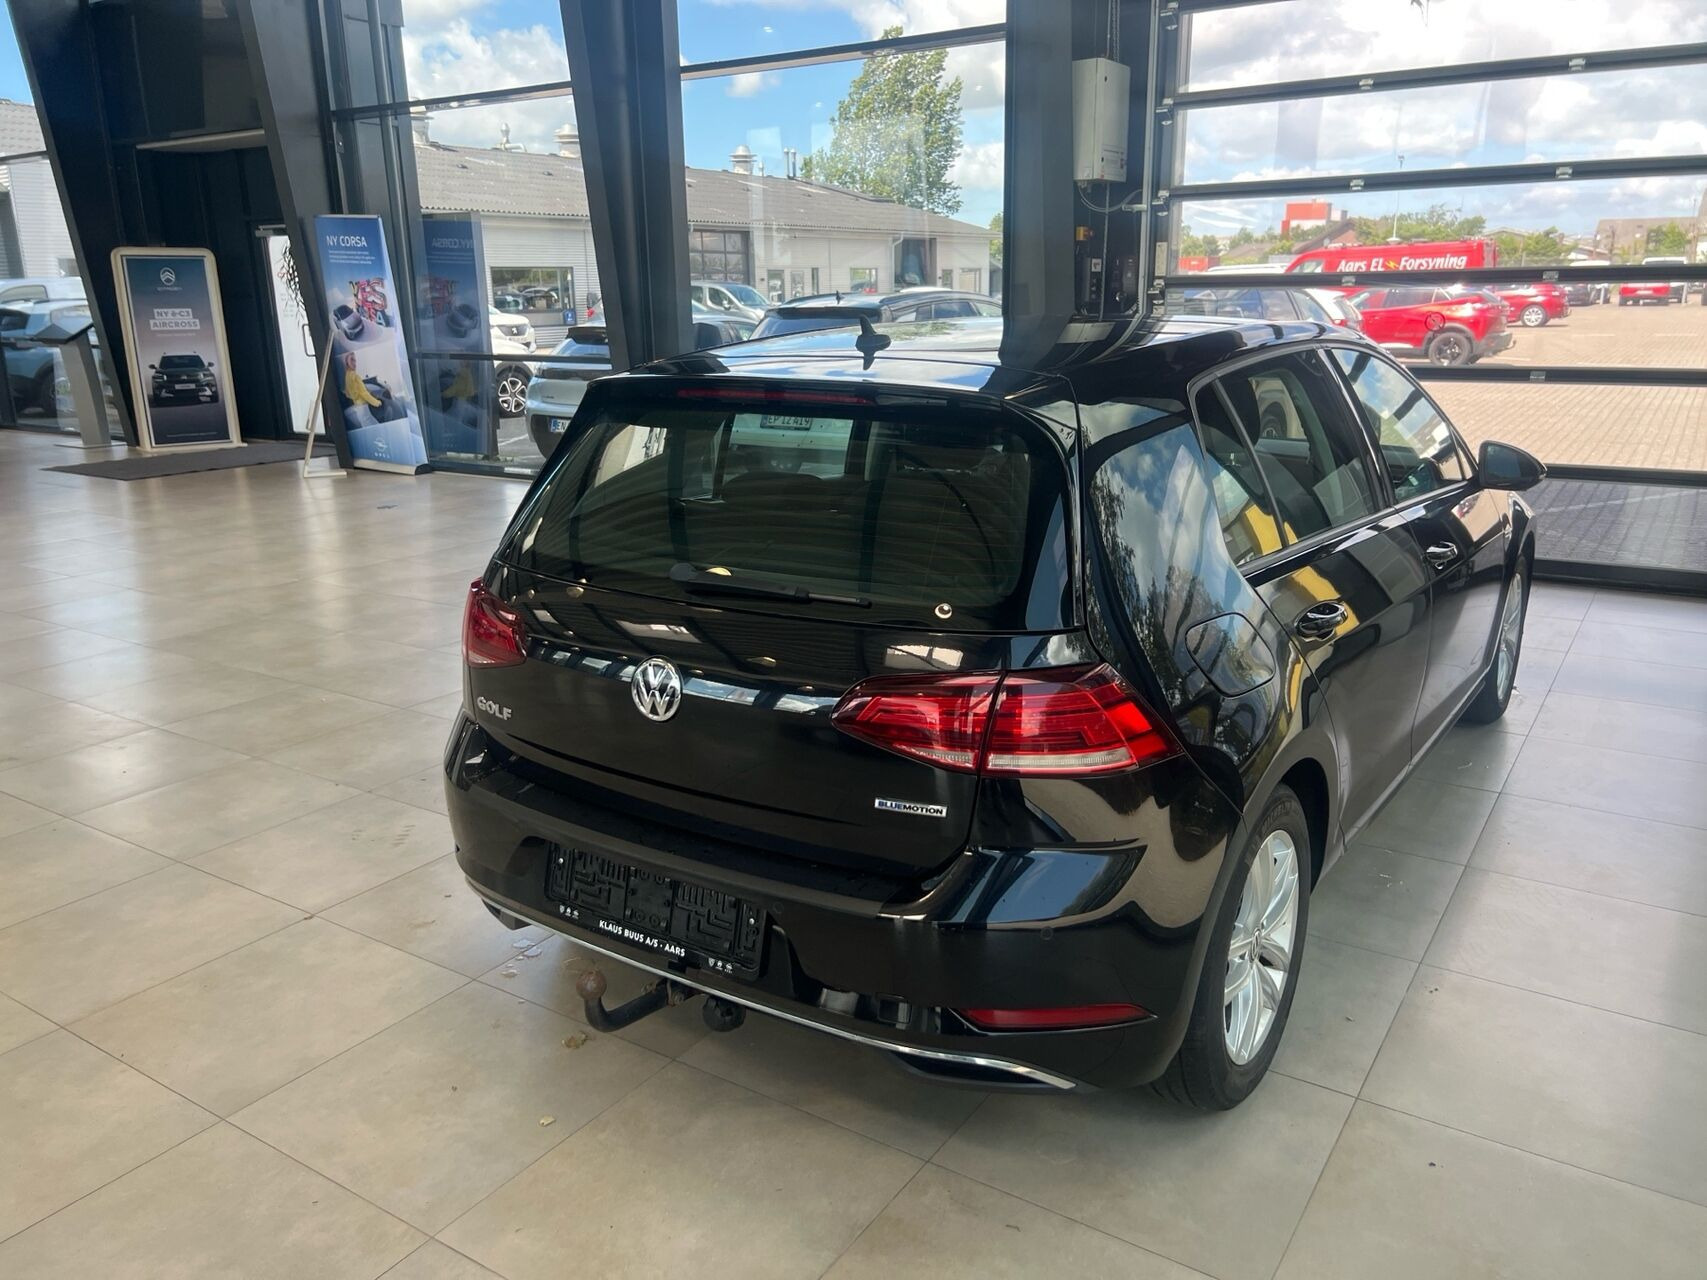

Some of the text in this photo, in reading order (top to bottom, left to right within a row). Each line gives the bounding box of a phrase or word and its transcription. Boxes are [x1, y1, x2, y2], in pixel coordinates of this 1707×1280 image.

[326, 235, 368, 247] NY CORSA
[1337, 254, 1467, 272] Aars EL Forsyning
[152, 320, 198, 328] AIRCROSS
[476, 696, 512, 721] GOLF
[878, 800, 943, 815] BLUEMOTION
[599, 919, 685, 957] KLAUS BUUS A/S AARS
